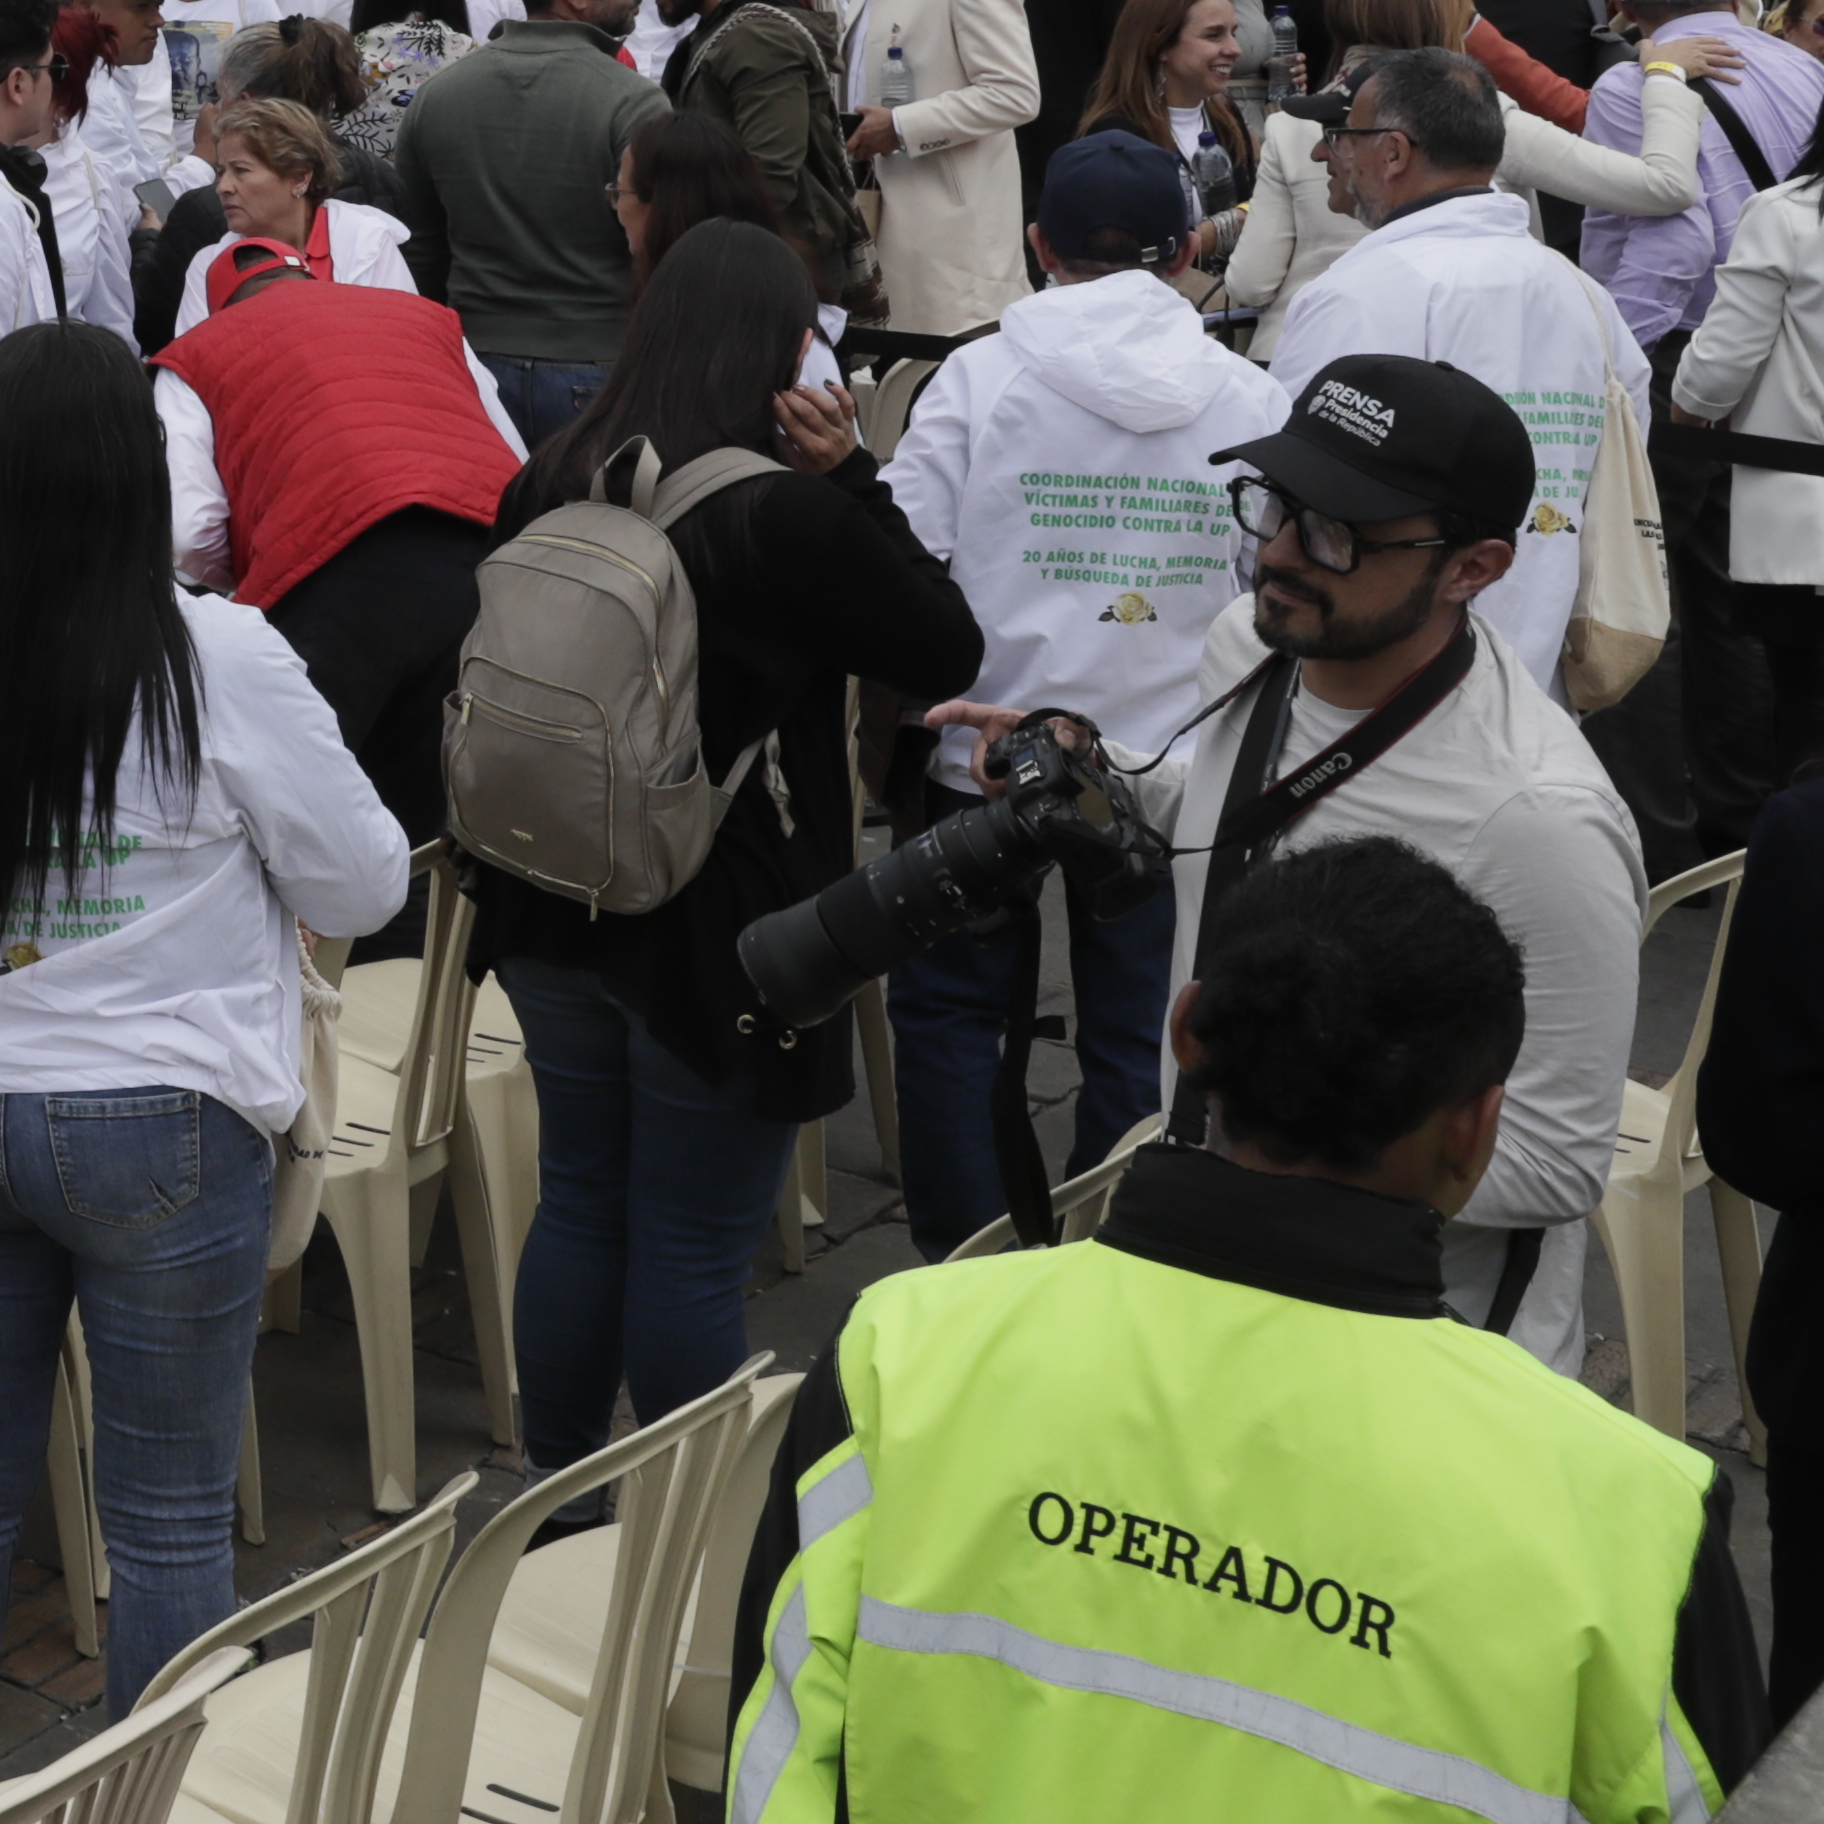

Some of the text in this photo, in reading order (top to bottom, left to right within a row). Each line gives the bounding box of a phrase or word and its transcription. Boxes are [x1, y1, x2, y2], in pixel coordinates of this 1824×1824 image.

[1318, 379, 1395, 428] PRENSA
[1318, 410, 1381, 447] de la República
[1324, 398, 1389, 438] Presidencia
[1584, 433, 1598, 447] UP
[1019, 473, 1226, 498] COORDINACIÓN NACIONAL
[1543, 486, 1559, 498] DE
[1024, 490, 1099, 509] VÍCTIMAS
[1105, 496, 1115, 509] Y
[1120, 496, 1210, 515] FAMILIARES
[1215, 504, 1234, 518] DE
[1030, 513, 1230, 537] GENOCIDIO CONTRA LA UP
[1022, 548, 1228, 572] 20 AÑOS DE LUCHA, MEMORIA
[1041, 565, 1204, 587] Y BÚSQUEDA DE JUSTICIA
[1289, 752, 1352, 798] Canon
[118, 833, 143, 850] DE
[109, 847, 131, 868] UP
[56, 895, 146, 916] MEMORIA
[24, 921, 44, 938] DE
[49, 921, 122, 939] JUSTICIA
[1028, 1491, 1395, 1658] OPERADOR
